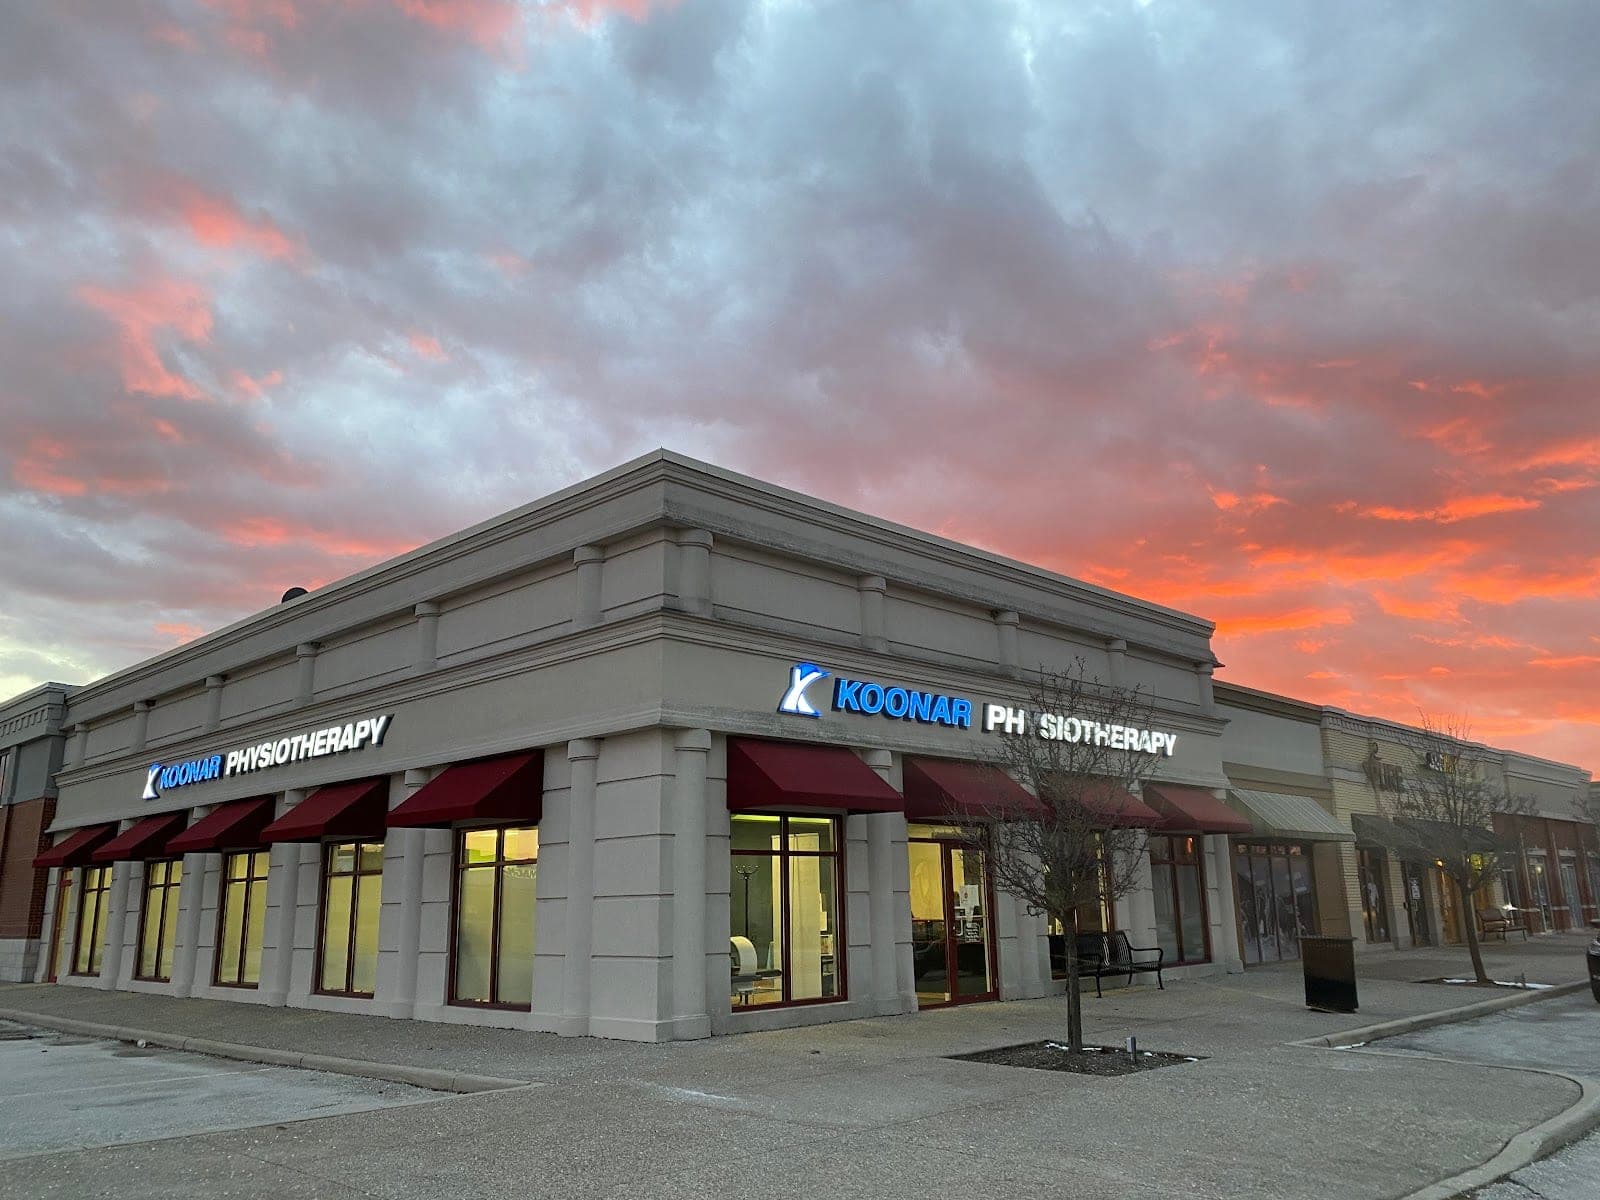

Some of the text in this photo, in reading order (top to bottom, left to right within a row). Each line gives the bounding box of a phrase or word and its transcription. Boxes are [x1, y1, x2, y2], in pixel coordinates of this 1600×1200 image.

[160, 755, 222, 790] KOONAR
[225, 715, 388, 776] PHYSIOTHERAPY
[835, 679, 972, 728] KOONAR
[985, 704, 1177, 757] PHSIOTHERAPY
